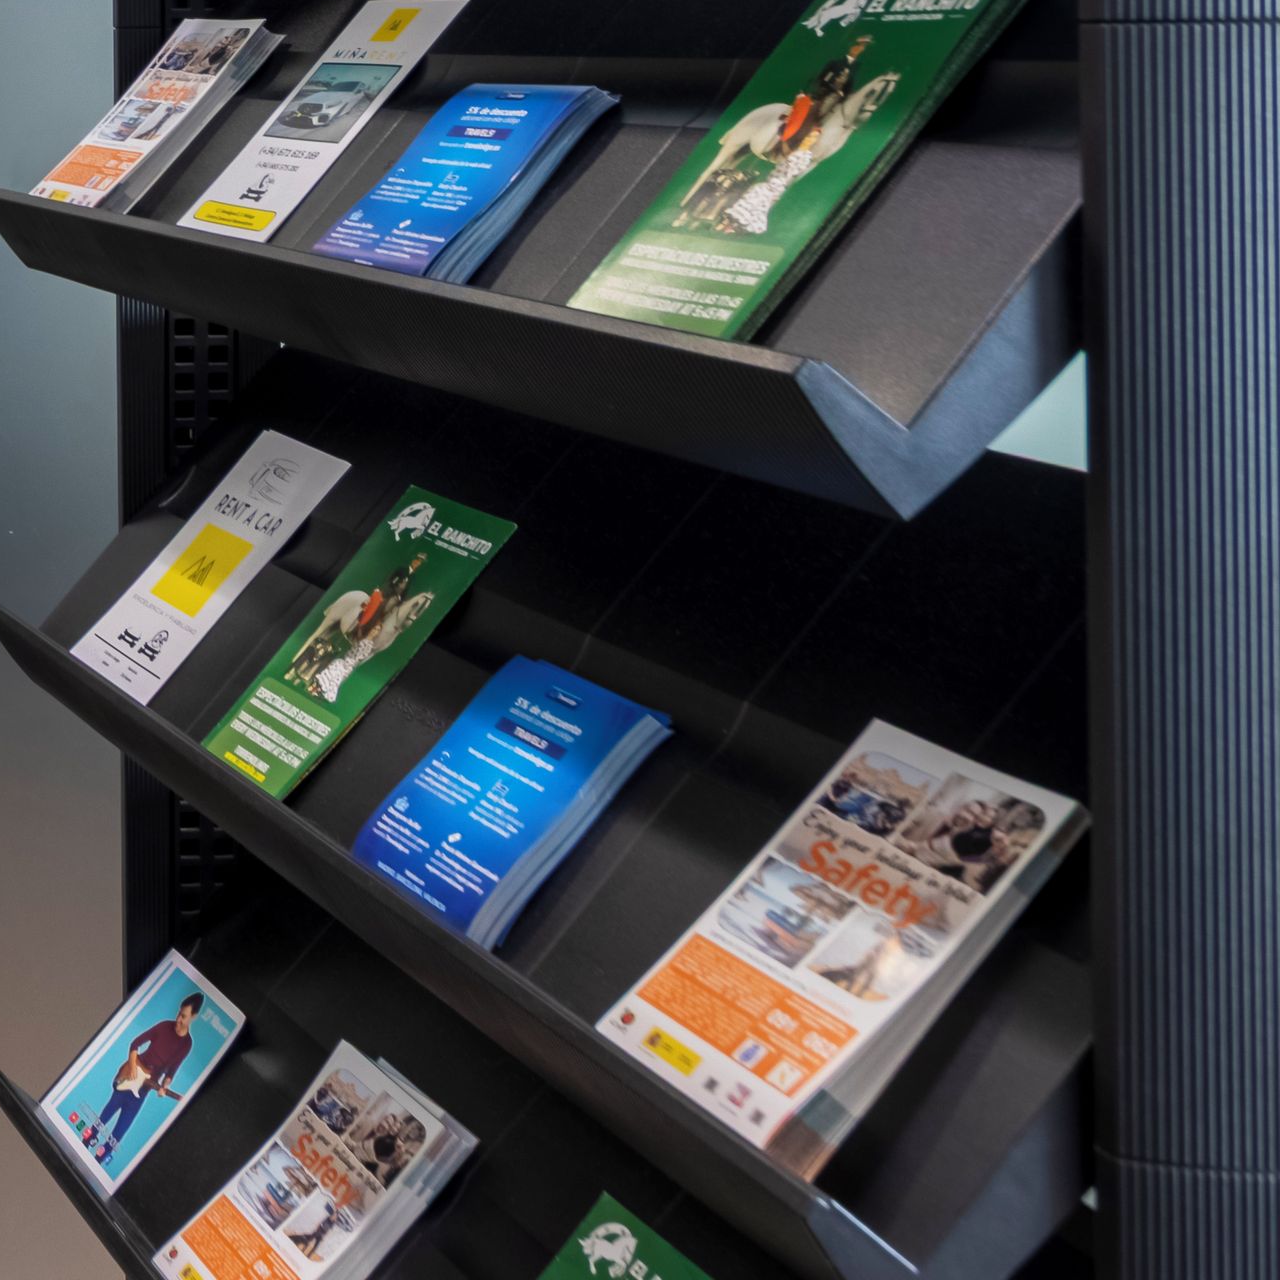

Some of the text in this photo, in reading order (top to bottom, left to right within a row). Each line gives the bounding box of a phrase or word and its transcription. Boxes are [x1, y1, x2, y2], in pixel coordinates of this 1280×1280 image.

[214, 493, 283, 537] RENT A CAR
[427, 520, 493, 555] EL RANCHITO
[798, 840, 939, 930] Safety
[290, 1132, 360, 1210] Safety
